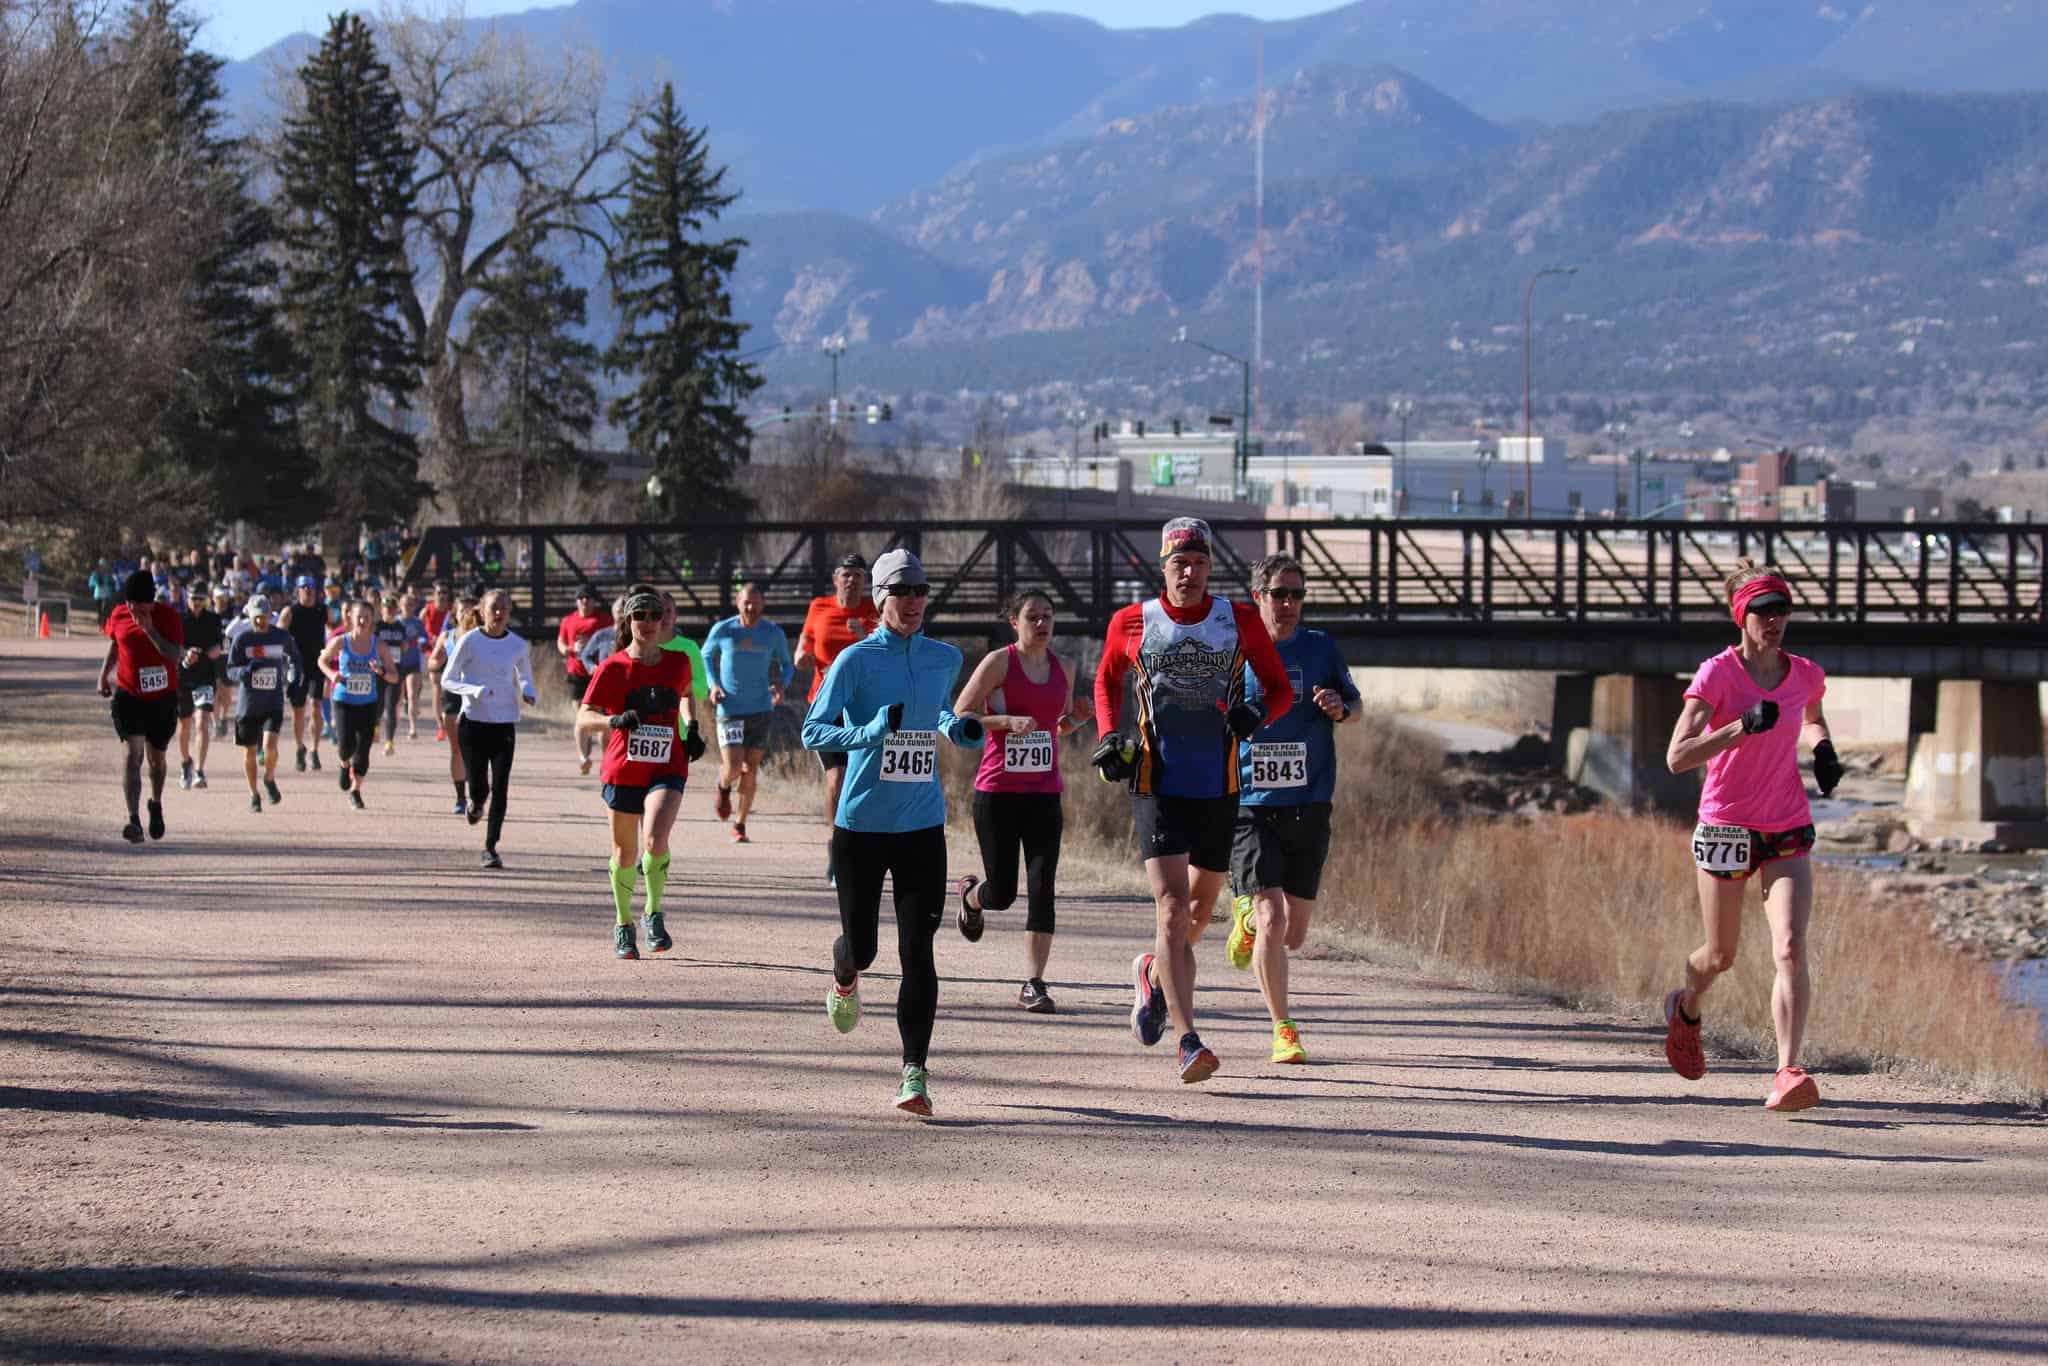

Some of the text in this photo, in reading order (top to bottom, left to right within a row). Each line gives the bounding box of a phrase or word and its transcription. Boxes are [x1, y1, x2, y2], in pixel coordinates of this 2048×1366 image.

[629, 738, 670, 757] 5687
[1007, 746, 1051, 767] 3790
[883, 750, 934, 775] 3465
[1254, 760, 1304, 782] 5843
[1694, 840, 1747, 863] 5776
